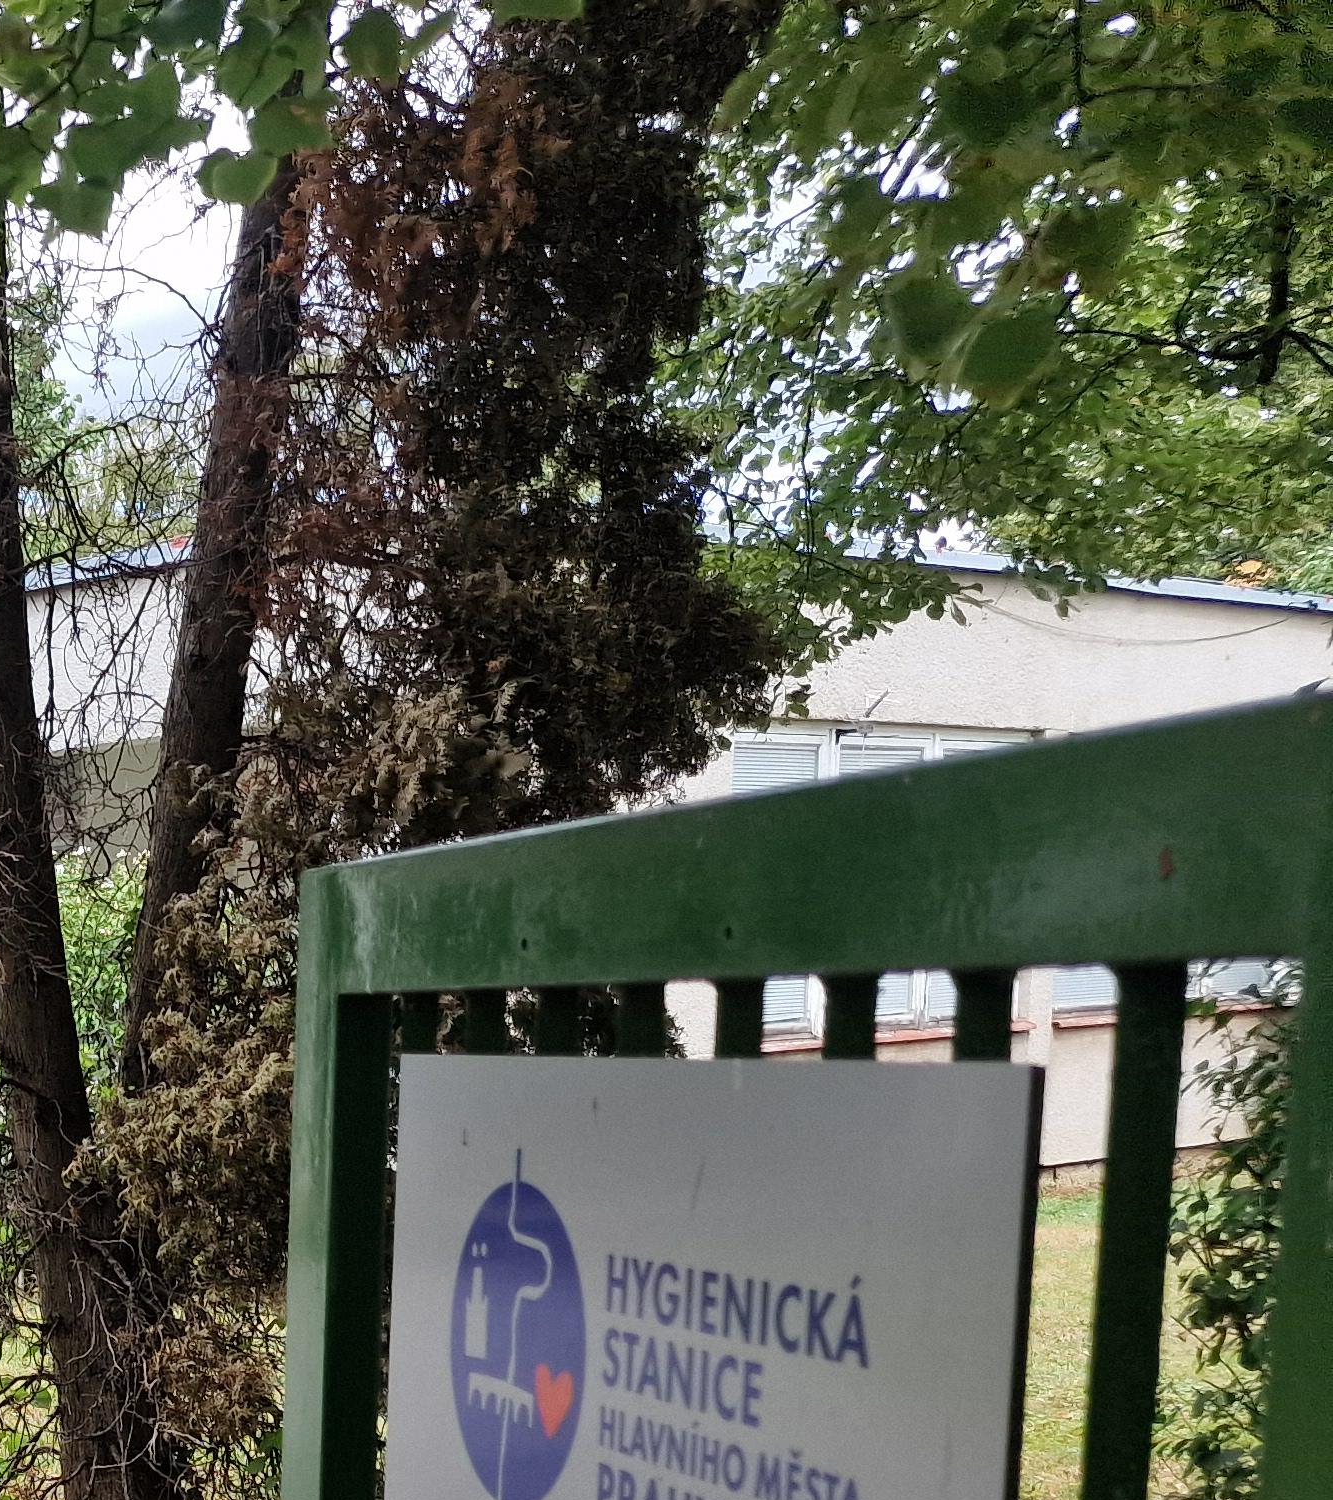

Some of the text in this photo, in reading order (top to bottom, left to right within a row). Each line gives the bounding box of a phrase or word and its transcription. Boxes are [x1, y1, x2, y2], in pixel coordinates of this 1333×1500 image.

[605, 1253, 869, 1370] HYGIENICKÁ
[602, 1326, 764, 1428] STANICE
[599, 1404, 748, 1493] HLAVNÍHO
